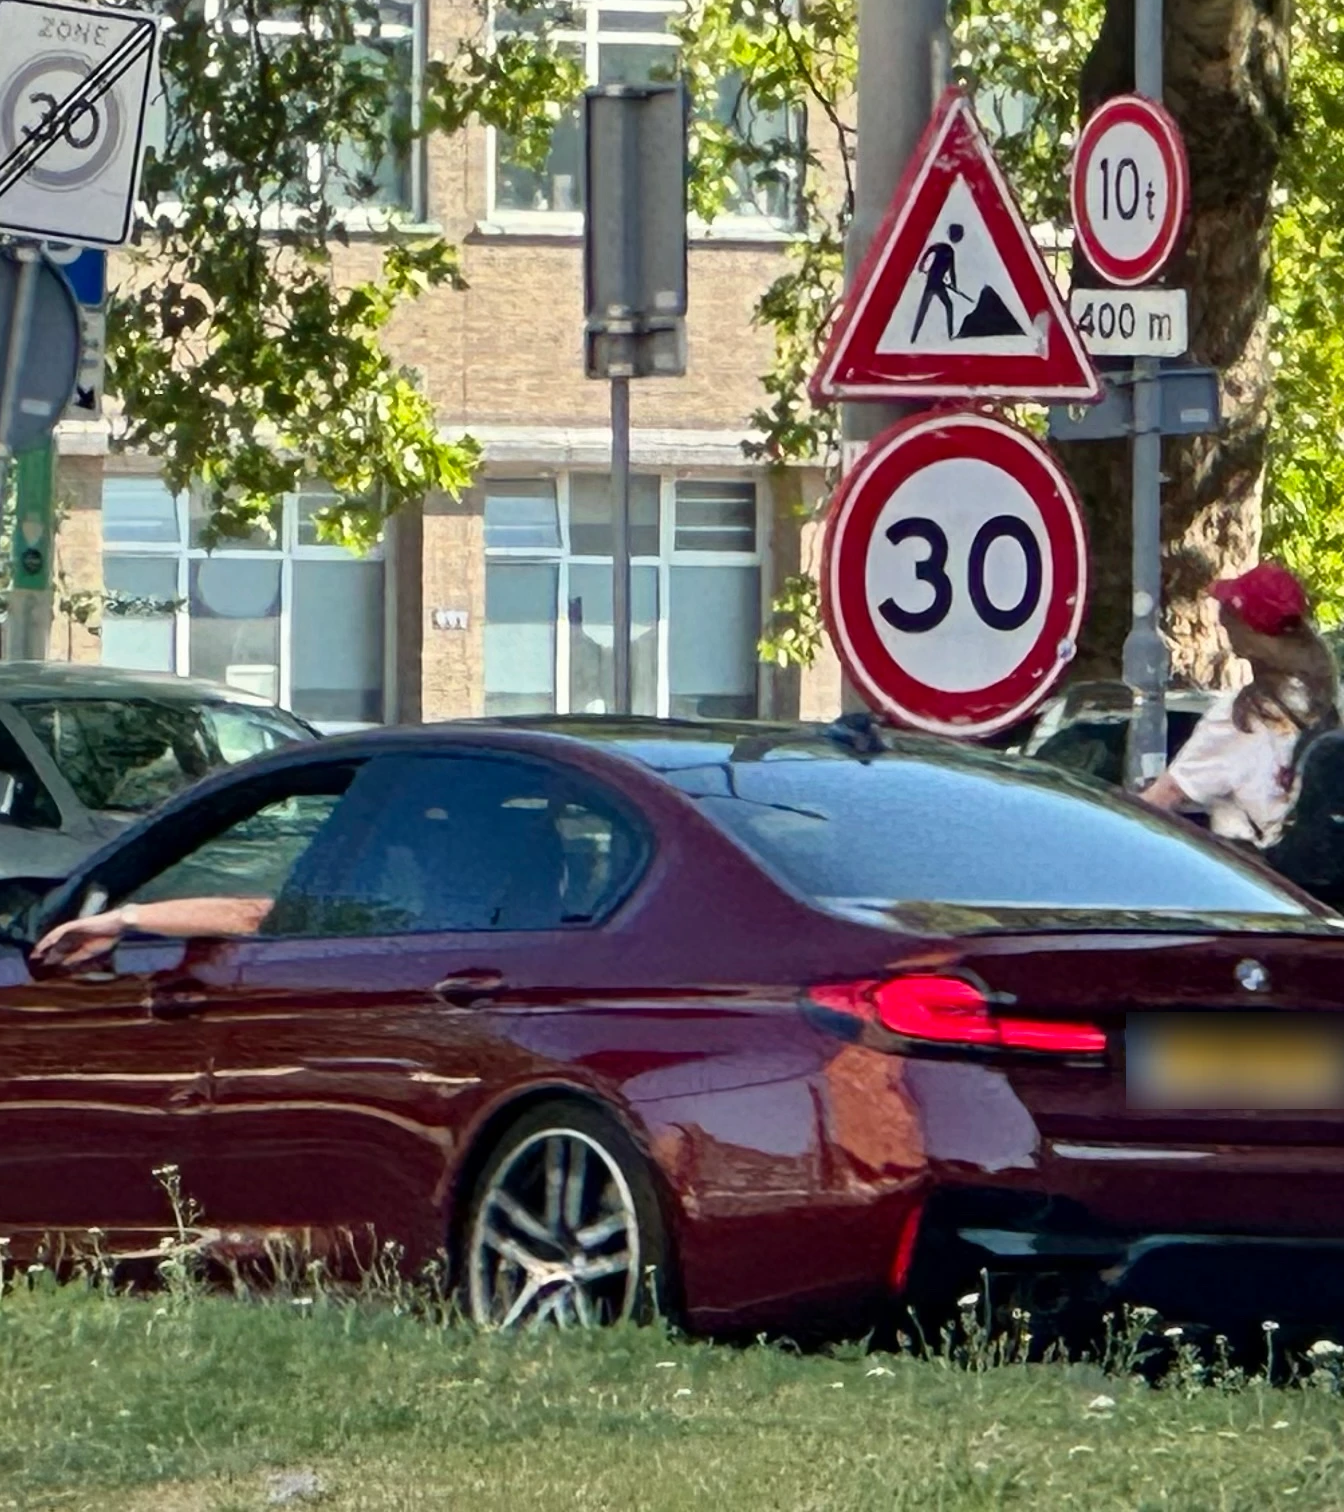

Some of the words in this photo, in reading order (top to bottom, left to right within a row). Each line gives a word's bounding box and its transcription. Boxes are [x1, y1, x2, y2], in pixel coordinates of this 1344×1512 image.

[37, 15, 110, 47] ZONE
[21, 91, 100, 150] 30
[1077, 302, 1135, 338] 400
[1148, 311, 1172, 341] m
[877, 514, 1043, 634] 30
